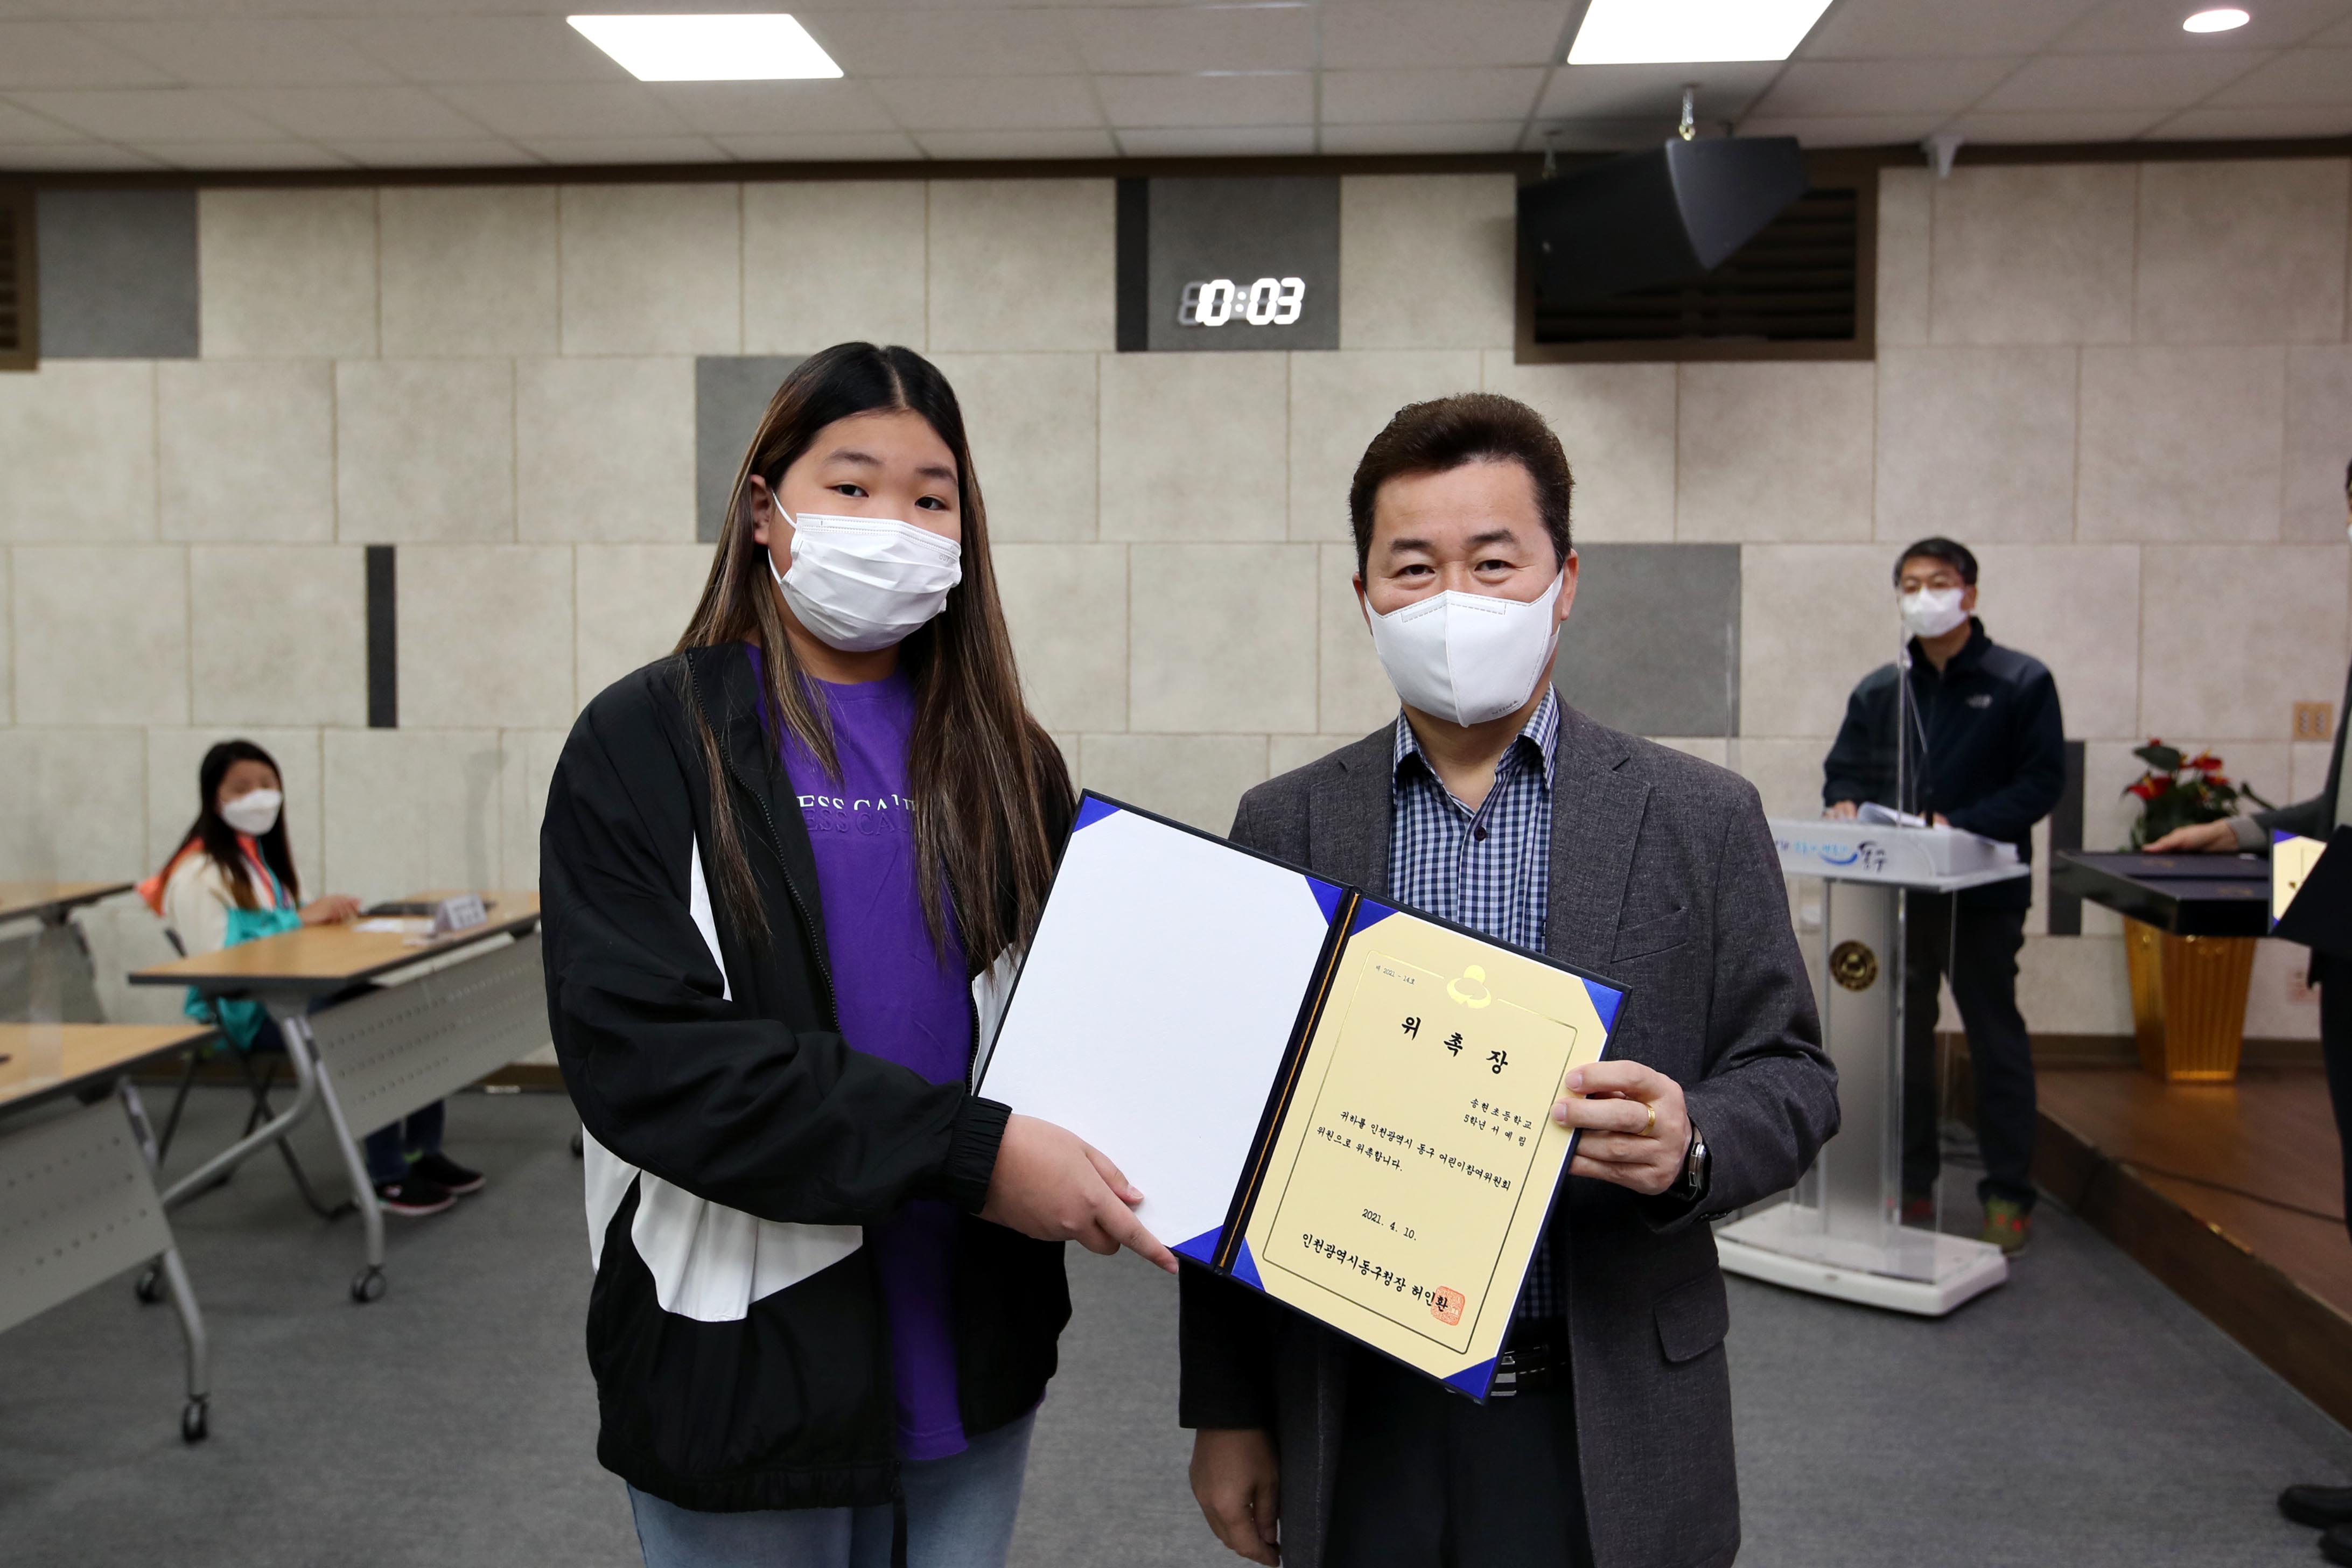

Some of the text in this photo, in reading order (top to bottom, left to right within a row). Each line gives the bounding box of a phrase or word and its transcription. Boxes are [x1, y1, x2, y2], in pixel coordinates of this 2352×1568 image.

[1195, 277, 1305, 326] 10:03
[1383, 968, 1395, 977] 2021
[1464, 1114, 1487, 1130] 5학년
[1469, 1098, 1533, 1130] 송현초등학교
[1317, 1126, 1403, 1172] 위원으로 위촉합니다.
[1340, 1111, 1512, 1192] 귀하를 인천광역시 동구 어린이참여위원회
[1362, 1208, 1417, 1241] 2021. 4. 10.
[1303, 1234, 1406, 1292] 인천광역시동구청장
[1412, 1285, 1448, 1312] 허인환
